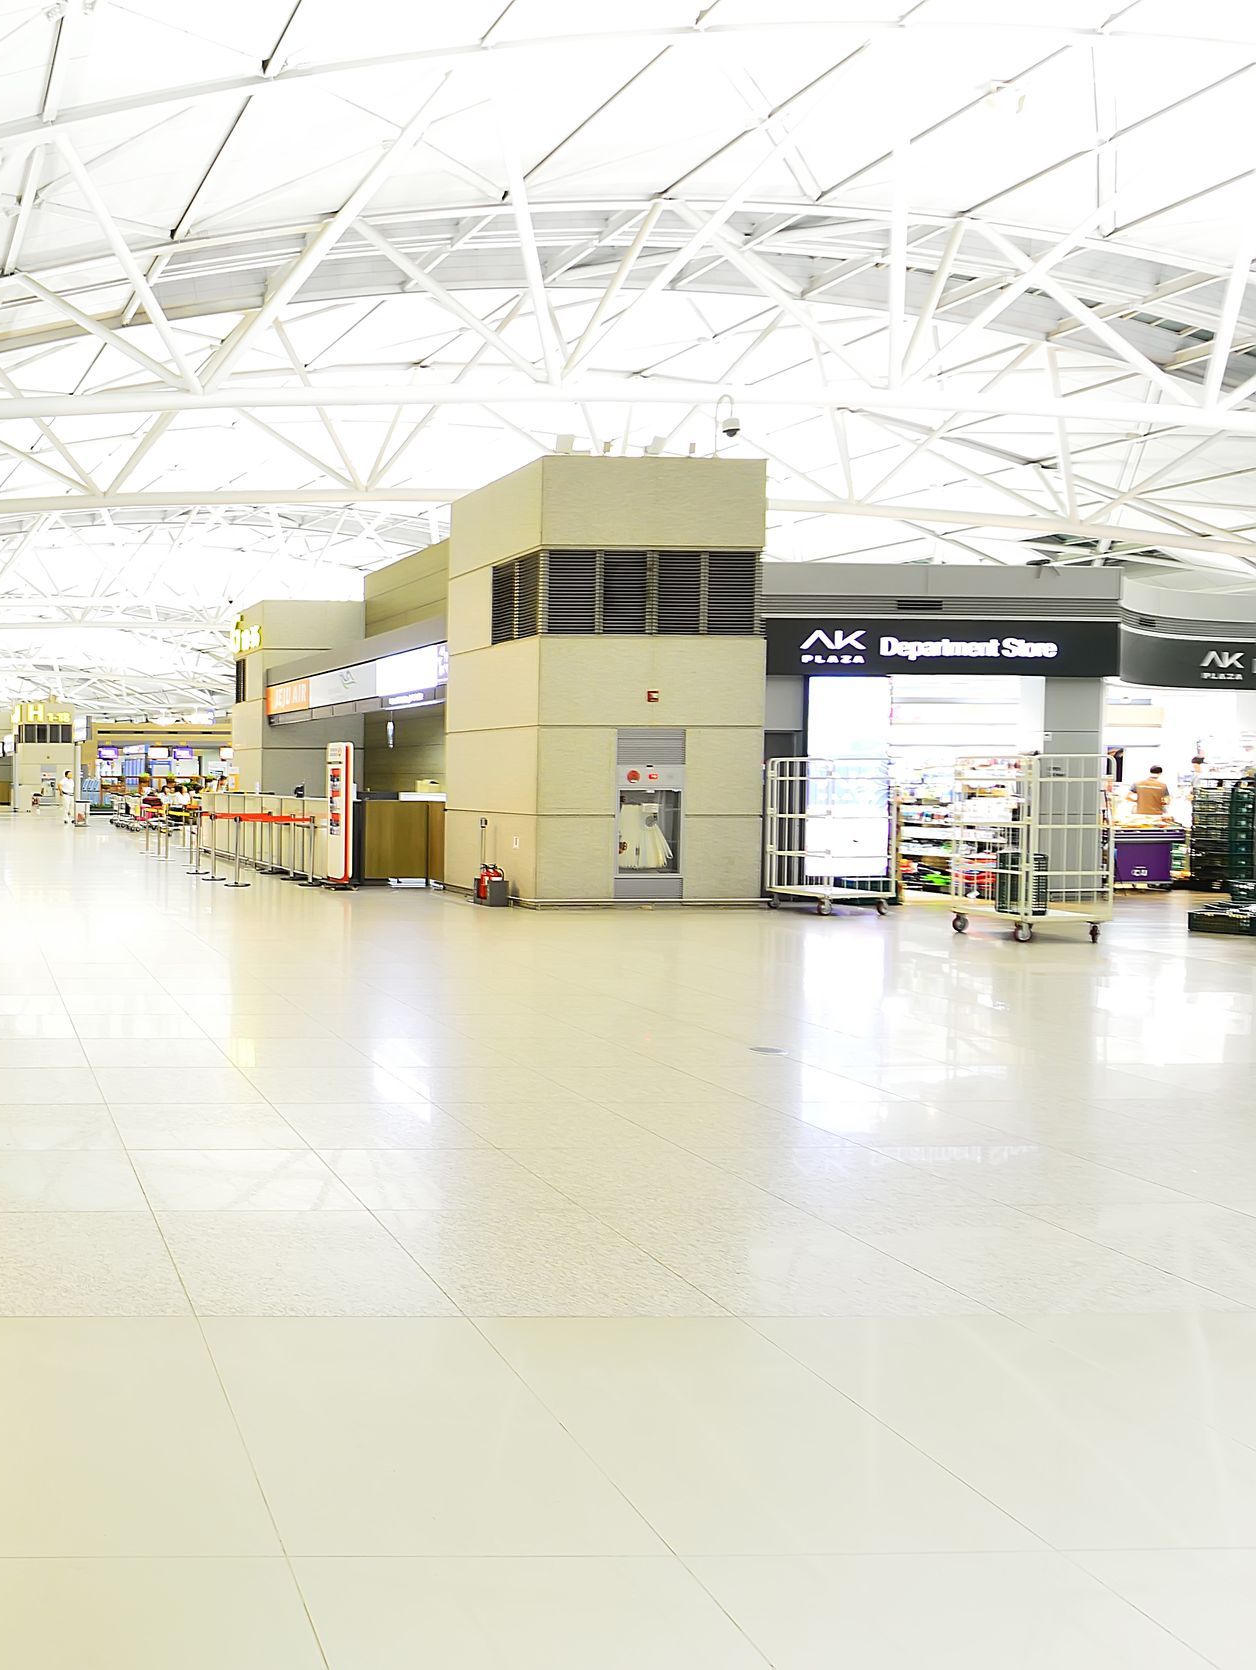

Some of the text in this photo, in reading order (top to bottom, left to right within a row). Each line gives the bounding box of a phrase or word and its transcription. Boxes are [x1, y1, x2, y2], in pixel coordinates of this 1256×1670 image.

[799, 629, 867, 650] AK
[880, 636, 1059, 661] Department Store
[800, 654, 866, 664] PLAZA
[1200, 650, 1245, 669] AK
[1200, 672, 1244, 681] PLAZA
[274, 682, 308, 709] JEJU AIR
[27, 703, 44, 722] H
